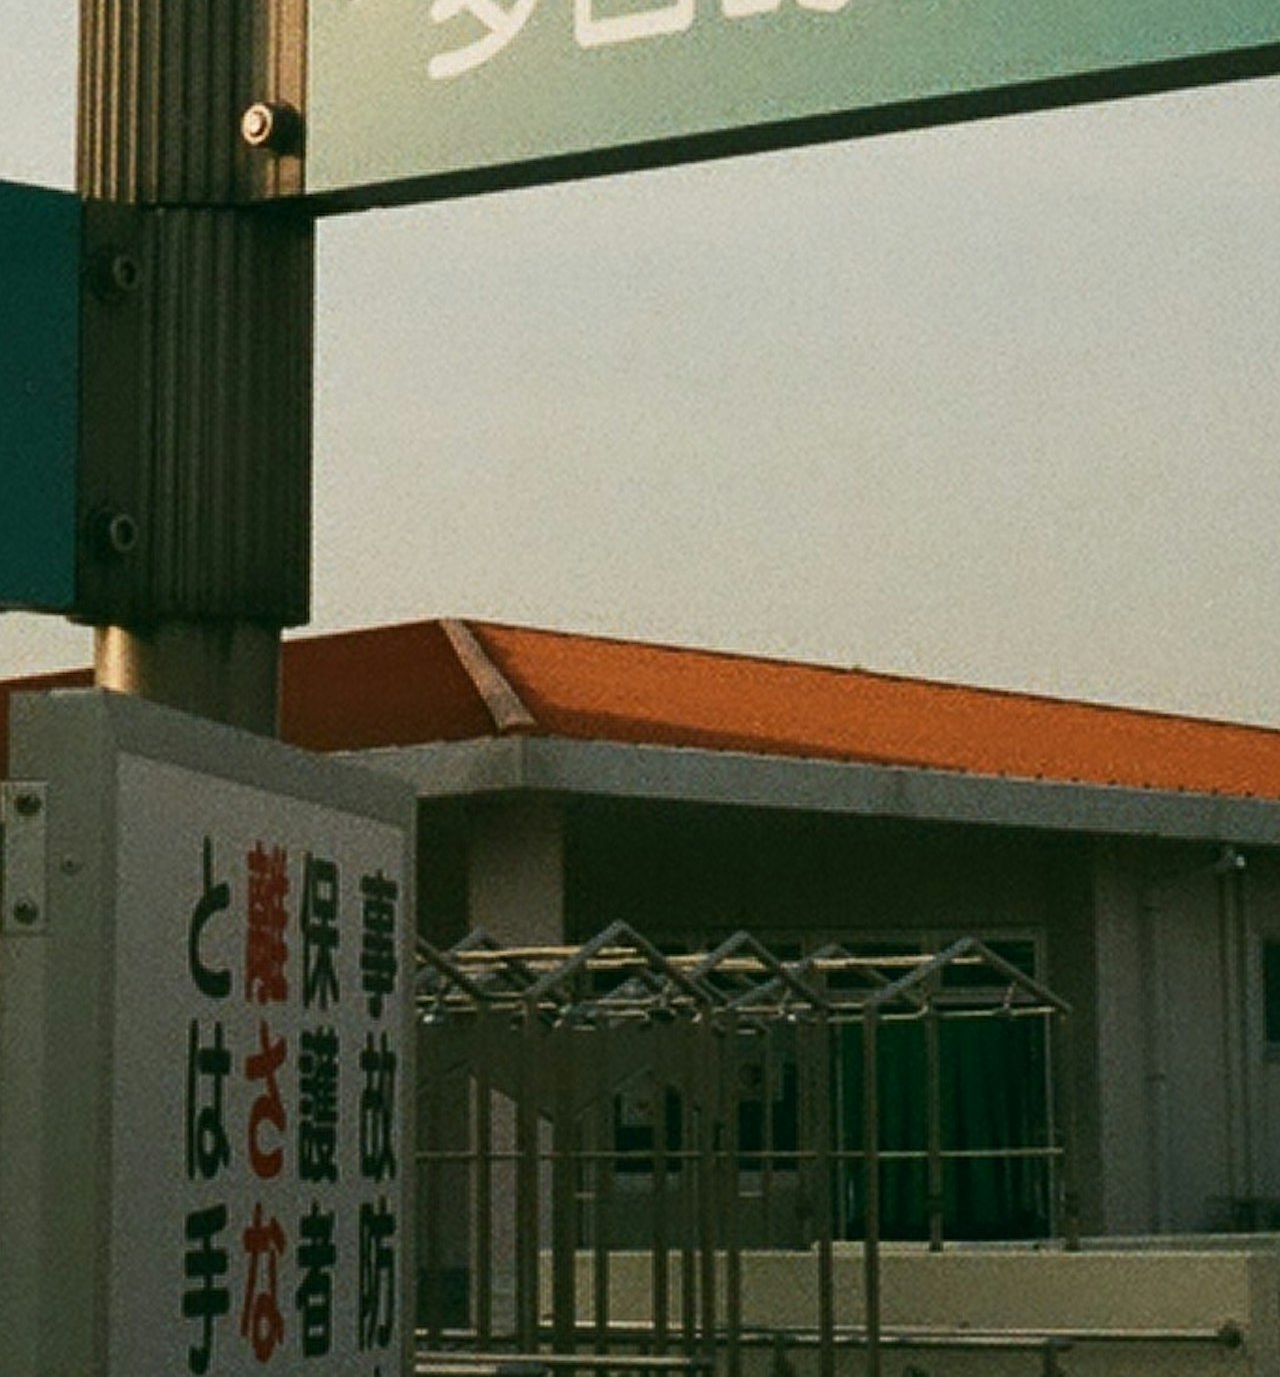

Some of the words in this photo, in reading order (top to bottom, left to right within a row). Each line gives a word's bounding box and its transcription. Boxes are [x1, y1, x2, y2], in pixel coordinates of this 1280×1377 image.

[183, 835, 231, 1375] とは手
[297, 850, 341, 1359] 保護者
[358, 870, 399, 1377] 事故防
